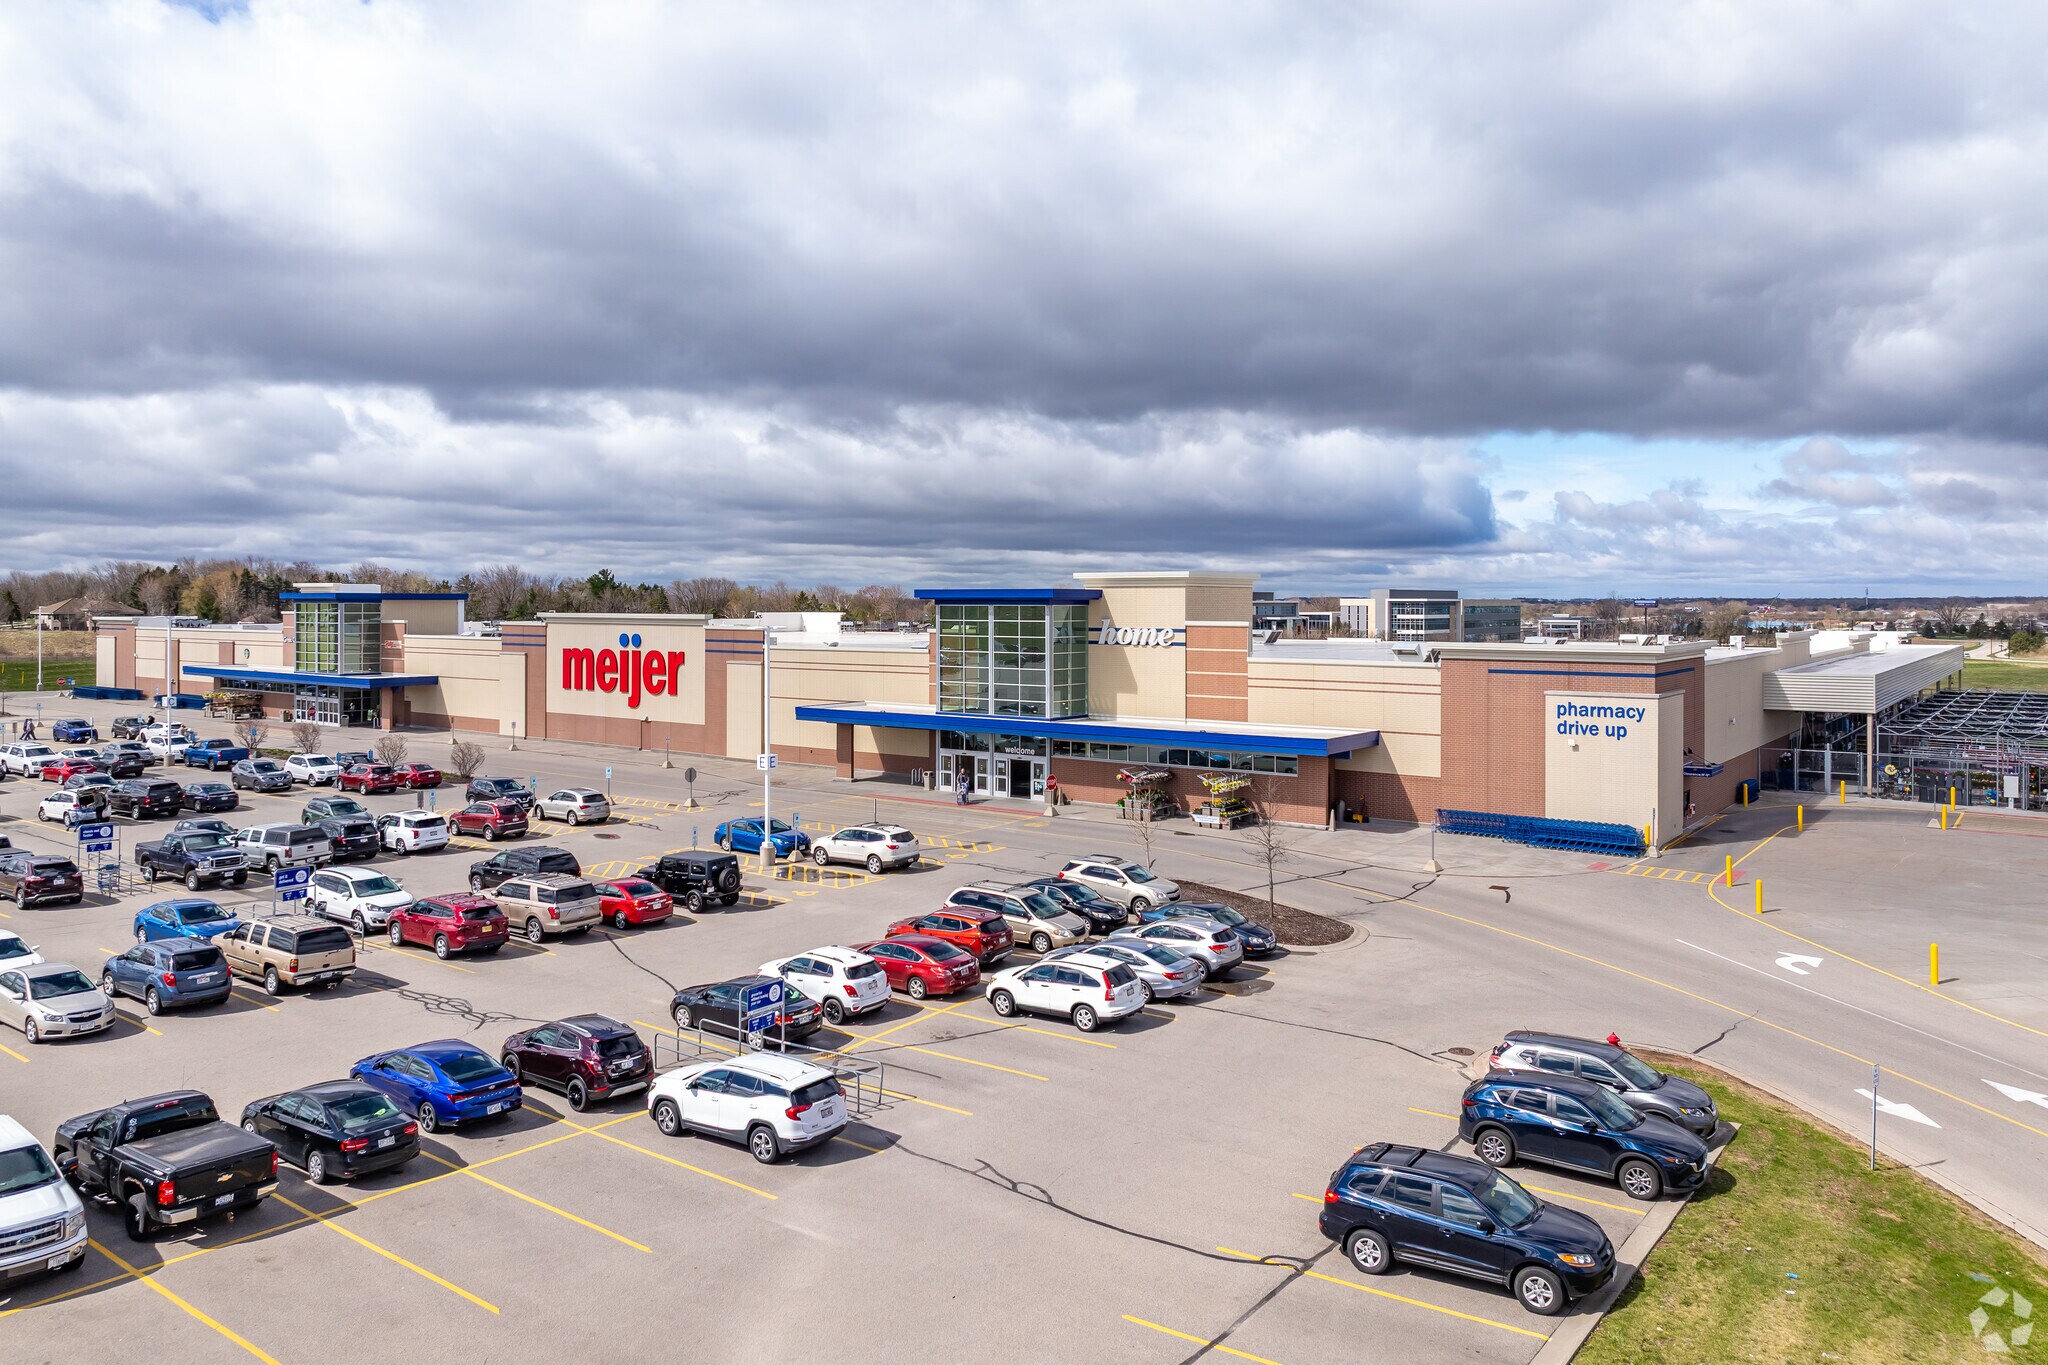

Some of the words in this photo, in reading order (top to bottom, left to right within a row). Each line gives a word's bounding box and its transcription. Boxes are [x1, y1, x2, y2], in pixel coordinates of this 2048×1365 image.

[1098, 618, 1174, 647] home
[562, 633, 685, 709] meijer
[1557, 702, 1646, 723] pharmacy
[1557, 720, 1599, 736] drive
[1605, 725, 1628, 741] up
[1005, 746, 1035, 755] welcome
[759, 756, 766, 769] E
[770, 755, 776, 769] E
